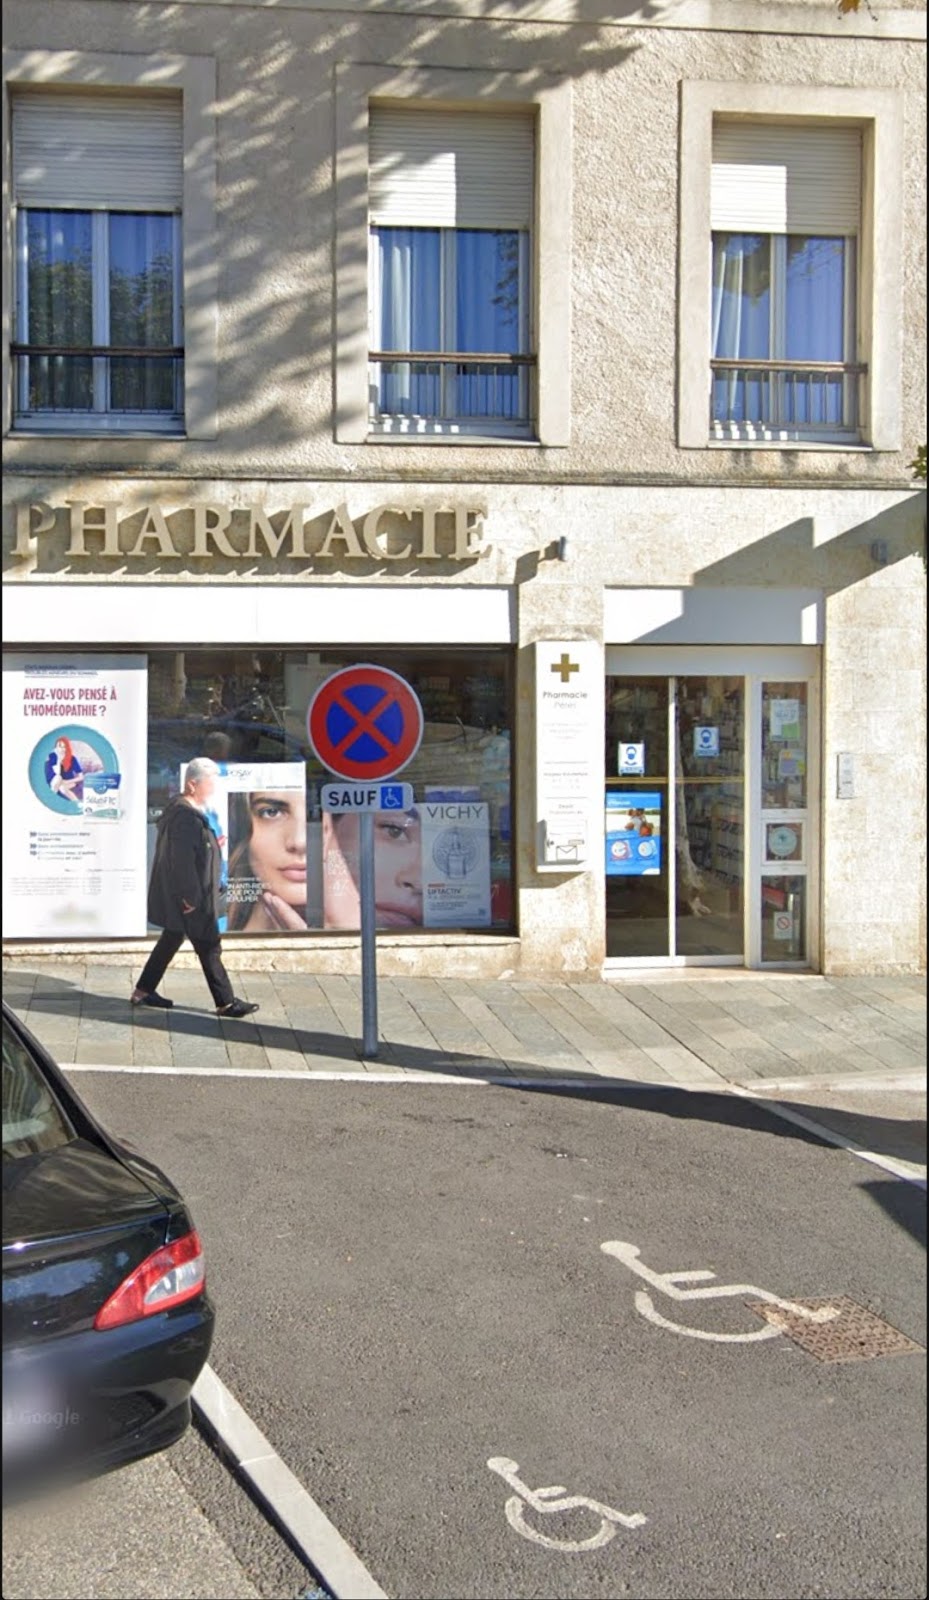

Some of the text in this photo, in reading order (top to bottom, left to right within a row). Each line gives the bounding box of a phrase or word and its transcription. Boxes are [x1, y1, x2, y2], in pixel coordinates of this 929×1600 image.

[12, 499, 494, 562] PHARMACIE
[23, 685, 117, 701] AVEZ-VOUS PENSÉ À
[542, 691, 588, 699] Pharmacie
[23, 702, 107, 717] L'HOMÉOPATHIE ?
[328, 790, 377, 807] SAUF
[427, 806, 485, 820] VICHY
